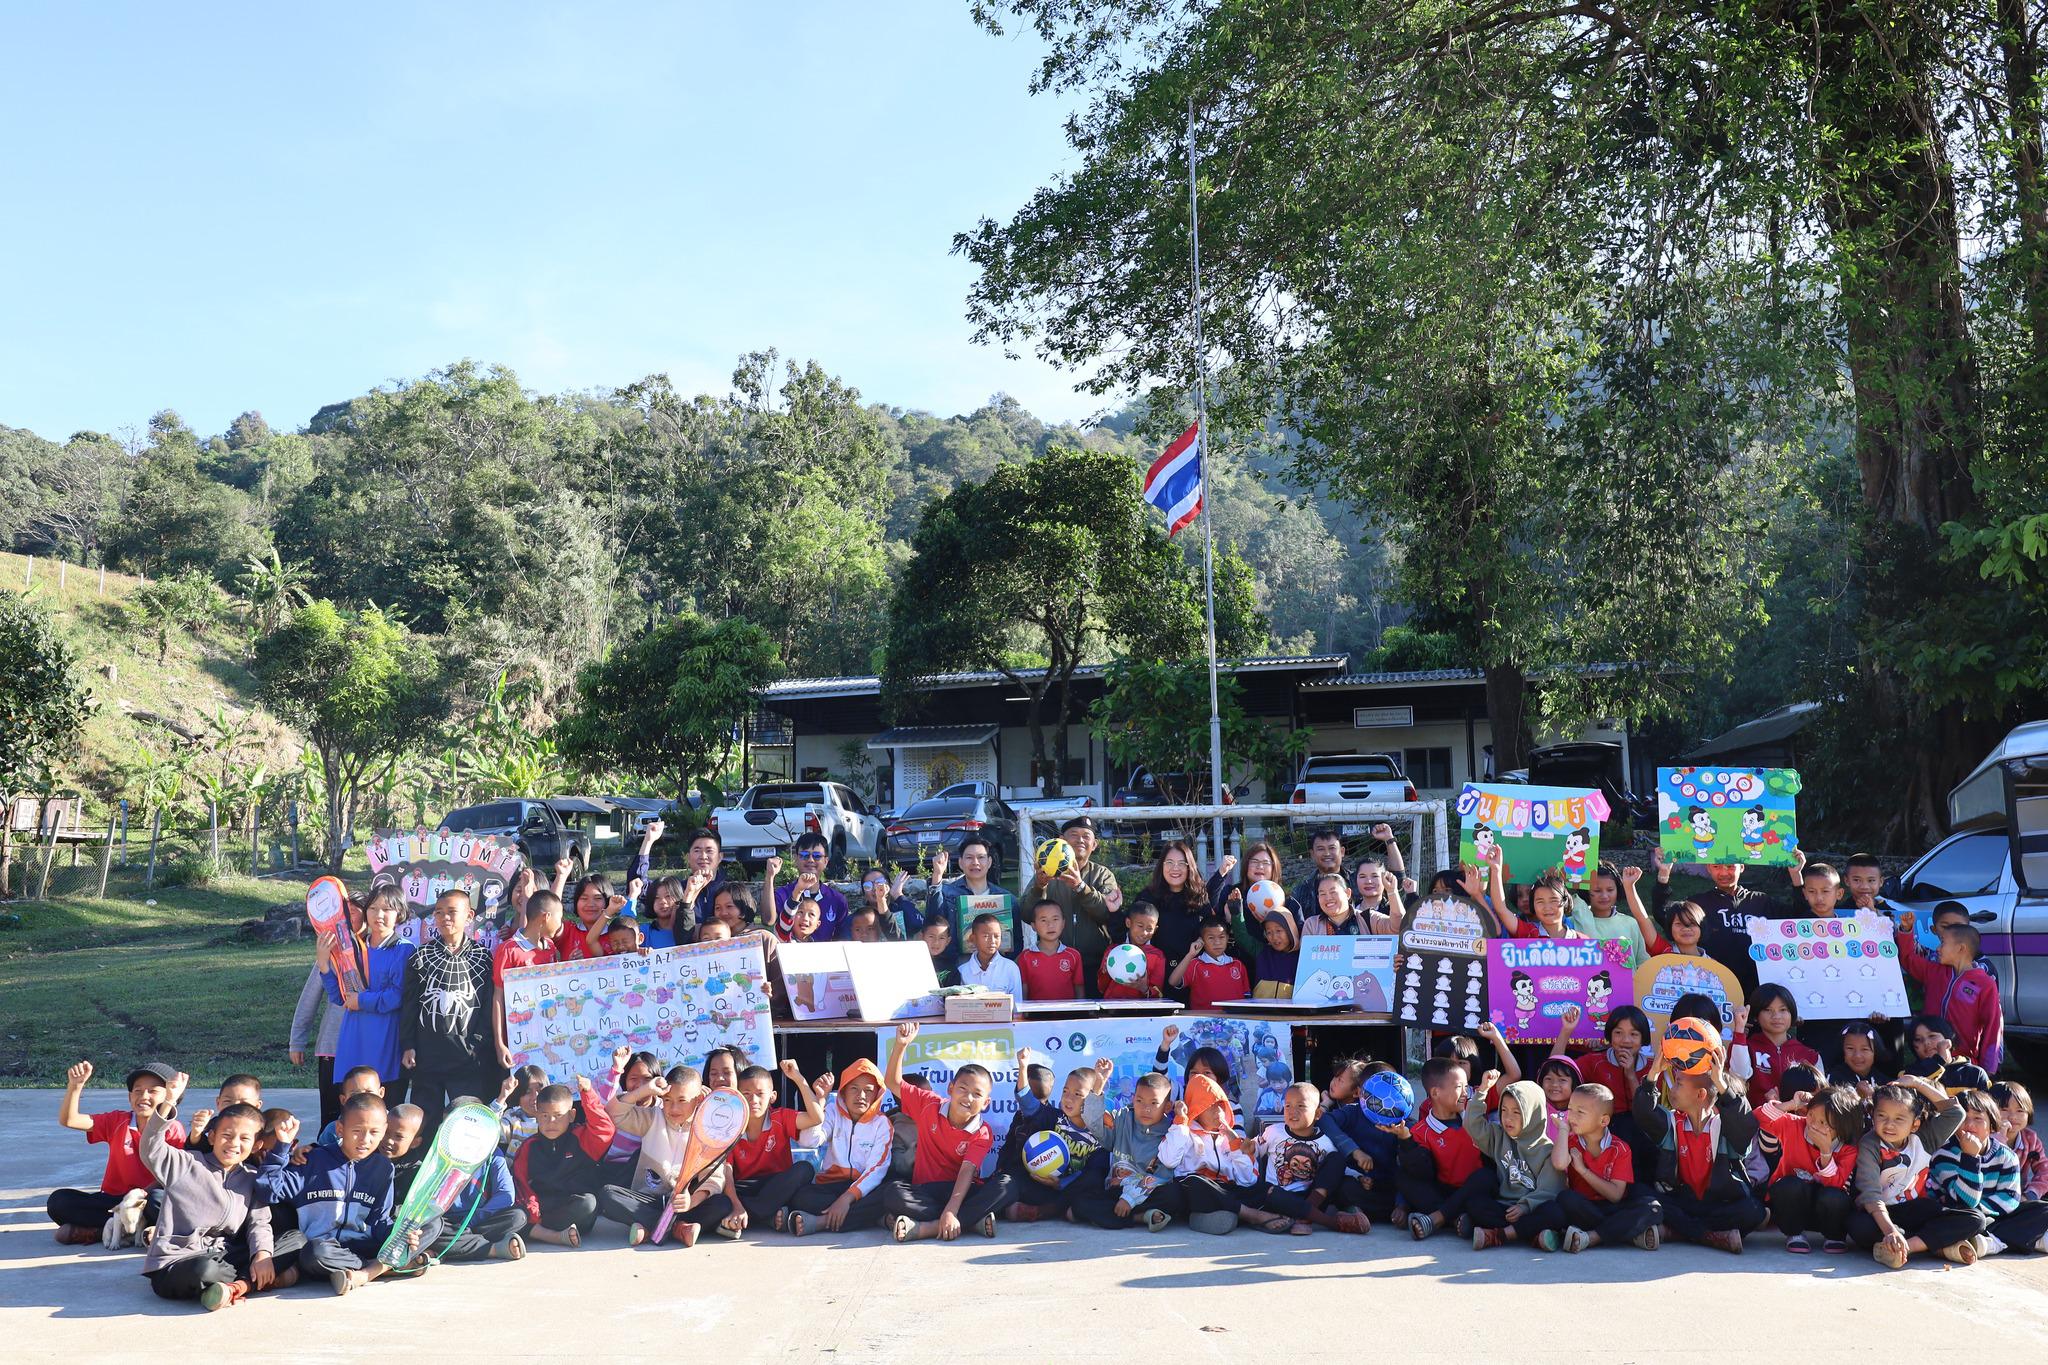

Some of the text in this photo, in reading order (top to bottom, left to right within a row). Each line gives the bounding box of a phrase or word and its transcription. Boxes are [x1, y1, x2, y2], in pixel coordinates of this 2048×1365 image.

[1456, 789, 1607, 828] ยินดีต้อนรับ
[374, 841, 512, 872] WELCOME
[974, 901, 998, 909] MAMA
[1475, 939, 1484, 953] 4
[1501, 940, 1603, 968] ยินดีต้อนรับ
[1756, 944, 1892, 959] ในห้องเรียน
[621, 952, 671, 970] อักษร A-Z
[512, 991, 530, 1005] Aa
[540, 983, 559, 997] Bb
[598, 977, 615, 990] Dd
[623, 973, 641, 987] Ee
[653, 971, 667, 983] Ff
[679, 965, 698, 978] Gg
[708, 961, 725, 974] Hh
[513, 1032, 529, 1045] Jj
[544, 1023, 561, 1036] Kk
[599, 1016, 620, 1031] Mm
[627, 1013, 645, 1027] Nn
[657, 1006, 677, 1019] Oo
[686, 1003, 705, 1017] Pp
[714, 998, 733, 1013] Qq
[1722, 1003, 1733, 1023] 5
[560, 1062, 576, 1075] Tt
[588, 1058, 606, 1071] Uu
[673, 1044, 691, 1058] Xx
[736, 1033, 754, 1046] Zz
[1755, 1051, 1771, 1068] K
[307, 1189, 318, 1200] IT'S
